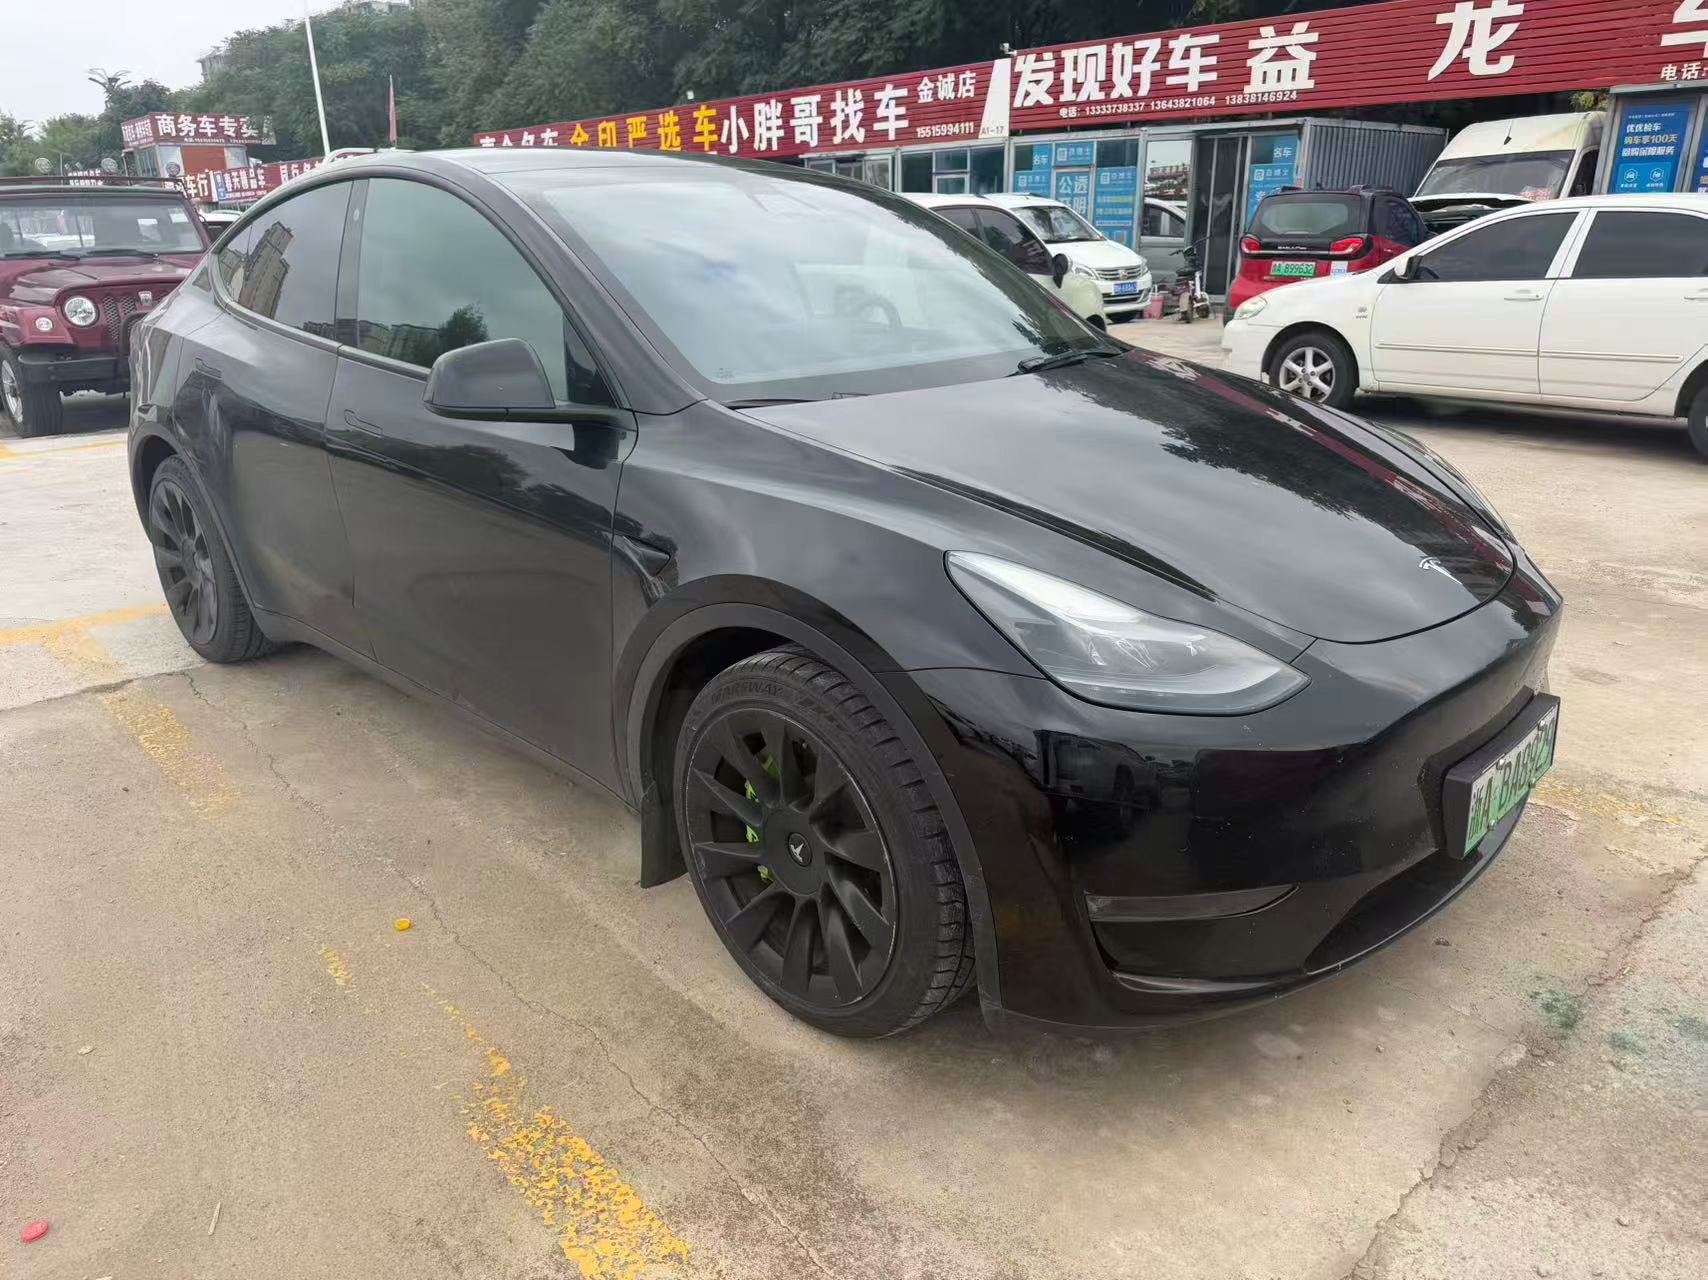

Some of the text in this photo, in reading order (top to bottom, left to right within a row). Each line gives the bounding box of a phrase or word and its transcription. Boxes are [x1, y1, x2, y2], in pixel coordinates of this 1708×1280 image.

[916, 70, 977, 104] 金诚店
[1012, 33, 1220, 108] 发现好车
[1150, 96, 1216, 111] 13643821064
[1224, 90, 1298, 105] 13838146924
[720, 84, 910, 154] 小胖哥找车
[916, 121, 974, 139] 15515994111
